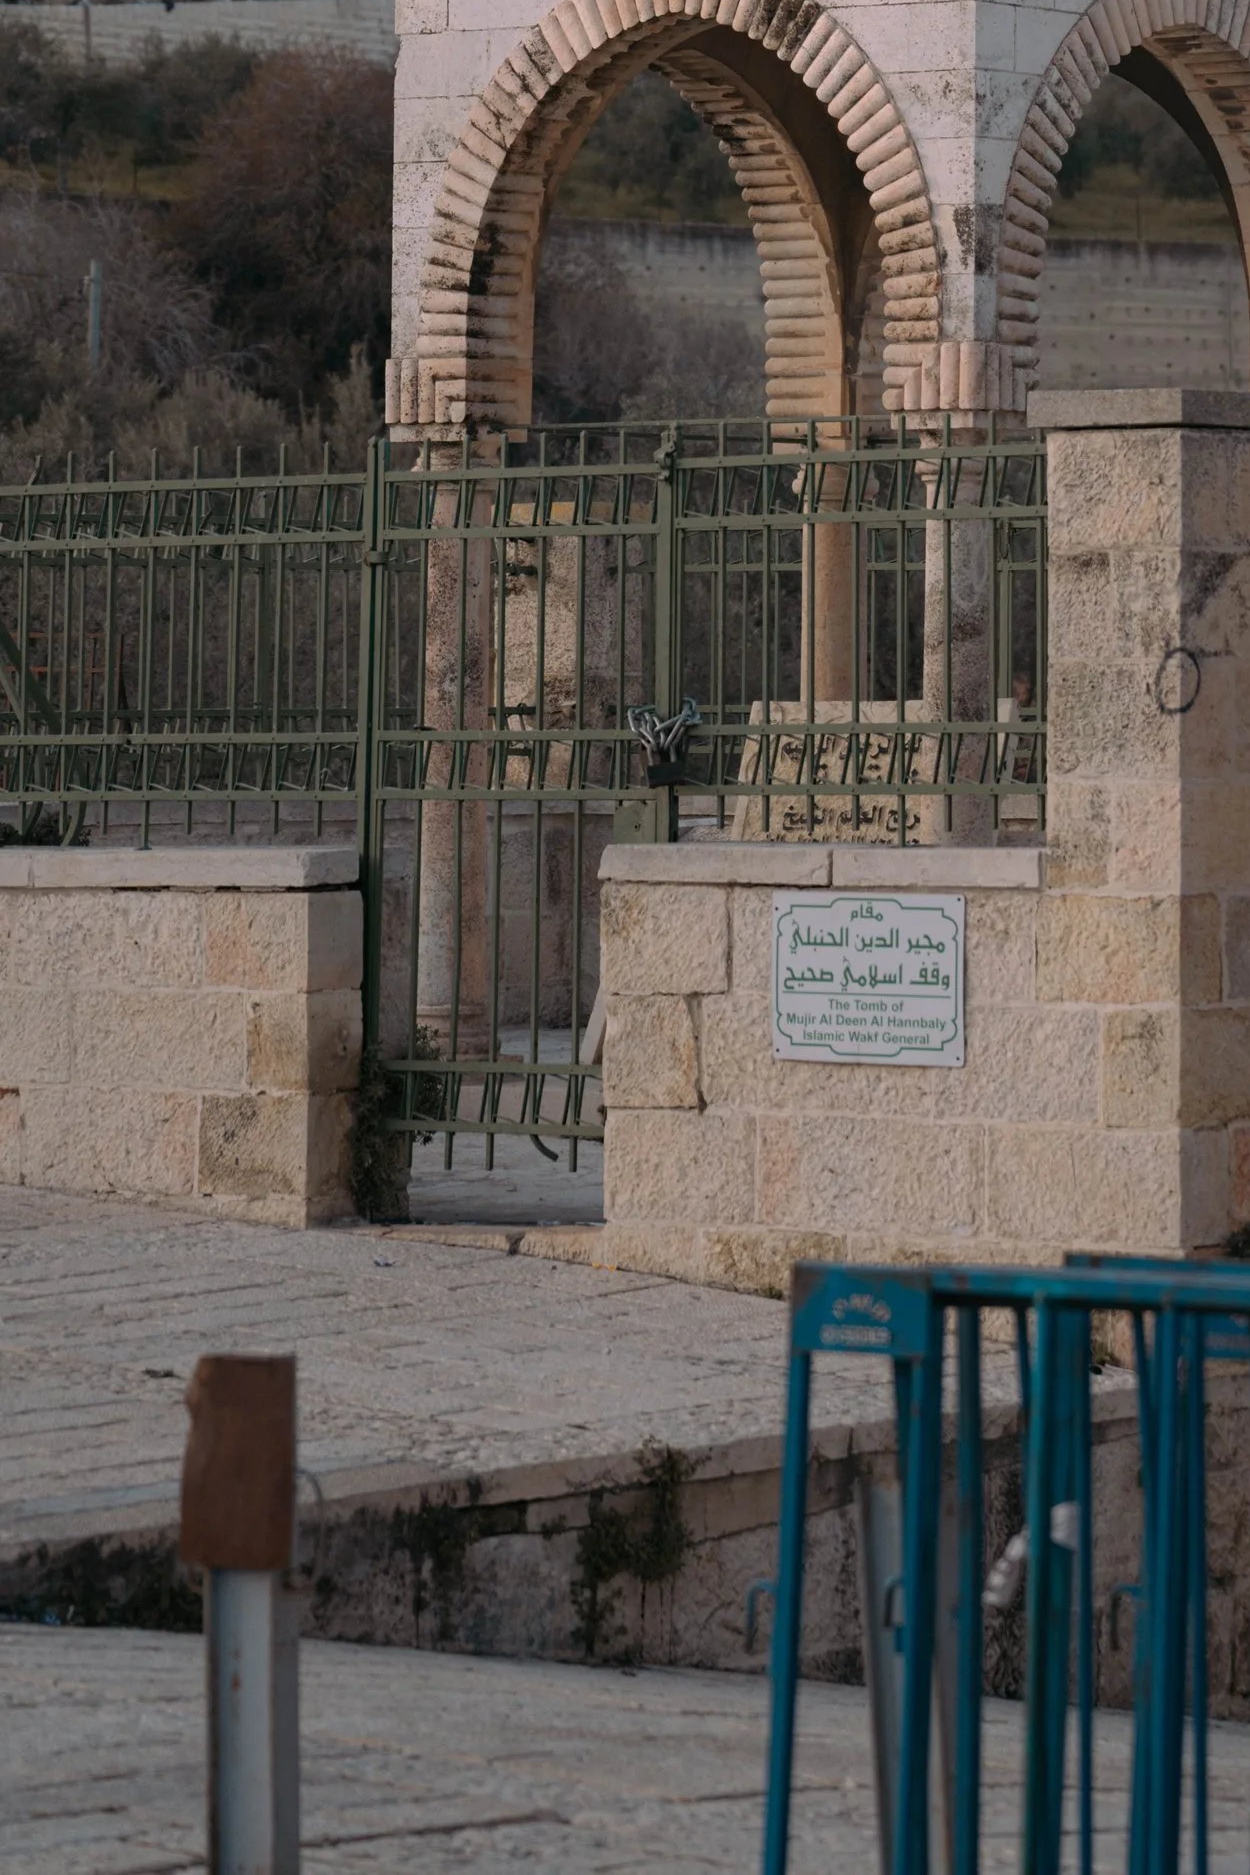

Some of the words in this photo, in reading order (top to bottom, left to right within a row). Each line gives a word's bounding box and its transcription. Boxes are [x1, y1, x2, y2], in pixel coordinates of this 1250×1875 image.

[850, 901, 883, 921] مقام
[790, 919, 849, 954] الحنبلي
[855, 928, 899, 953] الدين
[906, 934, 945, 955] مجير
[784, 966, 834, 989] صحيح
[840, 956, 902, 992] اسلامي
[910, 962, 950, 990] وقف
[828, 998, 850, 1010] The
[854, 1000, 888, 1011] Tomb
[892, 1001, 904, 1012] of
[787, 1013, 816, 1026] Mujir
[820, 1013, 831, 1025] Al
[836, 1016, 866, 1026] Deen
[871, 1016, 883, 1027] Al
[888, 1017, 946, 1031] Hannbaly
[803, 1030, 844, 1041] Islamic
[848, 1031, 878, 1042] Wakf
[882, 1033, 929, 1045] General
